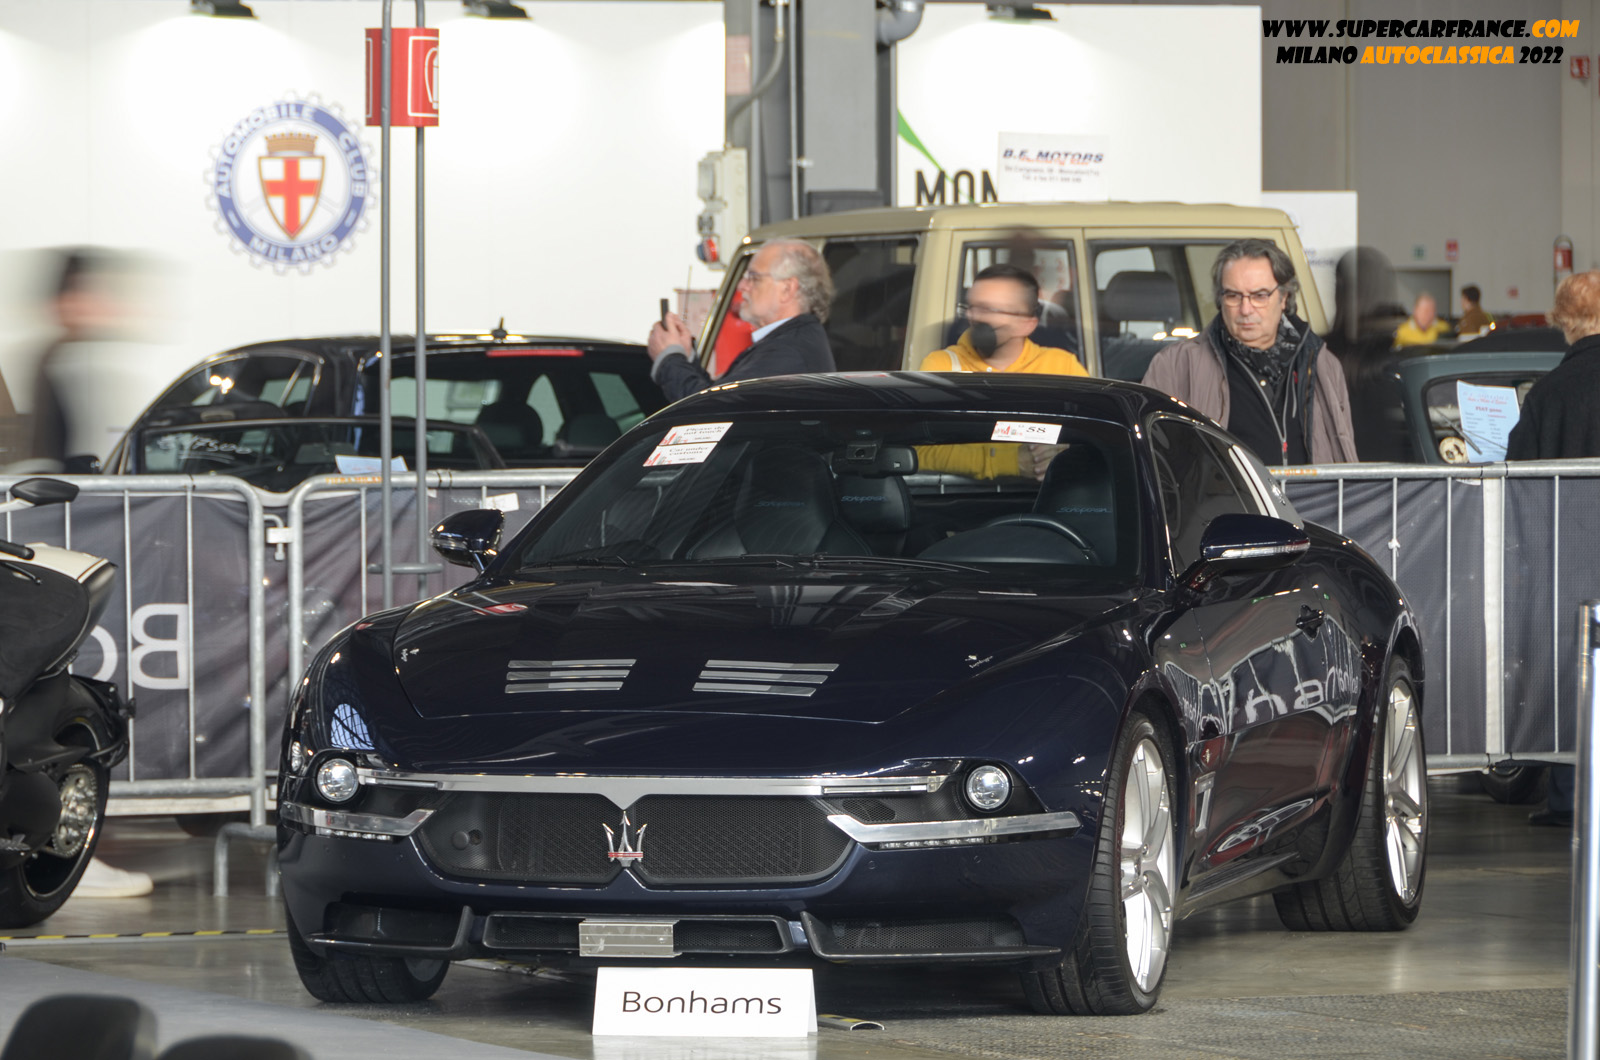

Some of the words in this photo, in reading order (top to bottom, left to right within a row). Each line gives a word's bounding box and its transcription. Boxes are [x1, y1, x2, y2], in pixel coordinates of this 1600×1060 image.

[215, 103, 315, 199] AUTOMOBILE
[338, 131, 367, 198] CLUB
[1036, 151, 1104, 163] MOTORS
[249, 234, 339, 262] MILANO
[354, 476, 383, 484] MILAN
[622, 990, 782, 1014] Bonhams
